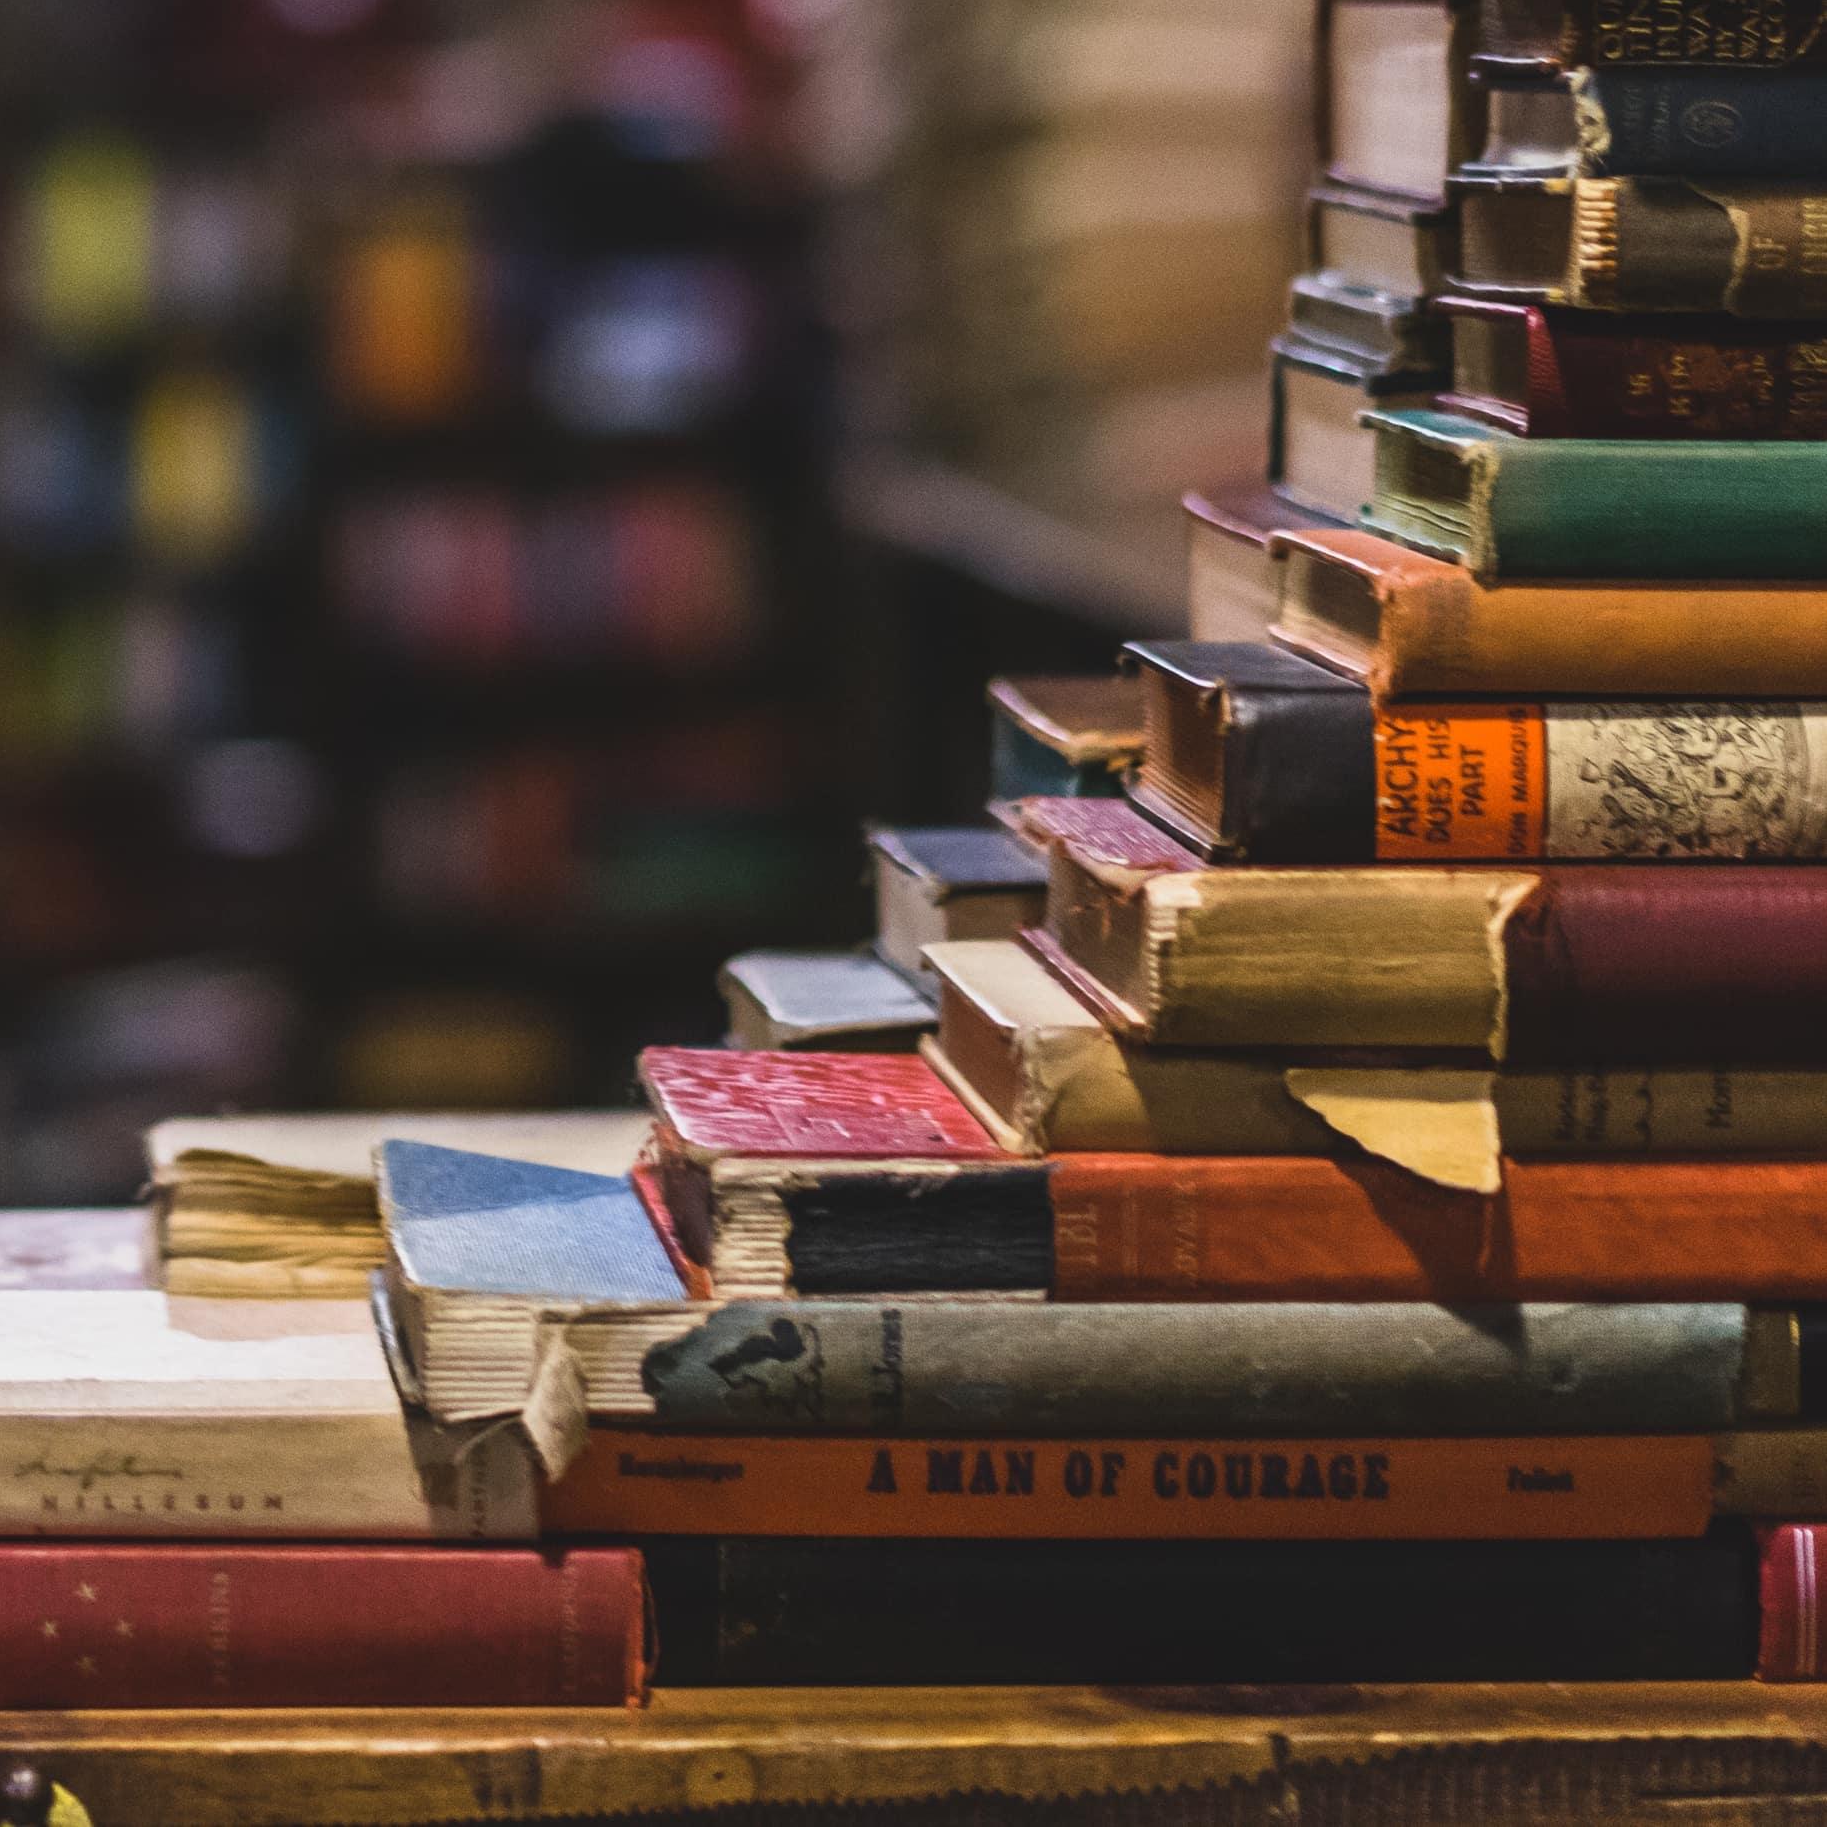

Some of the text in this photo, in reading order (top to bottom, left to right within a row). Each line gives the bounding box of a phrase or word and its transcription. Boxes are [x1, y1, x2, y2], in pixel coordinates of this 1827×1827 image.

[1382, 720, 1419, 838] ARCHY
[1425, 718, 1453, 843] DOES HIS
[1458, 744, 1486, 817] PART
[41, 1492, 284, 1512] HILLESUM
[865, 1450, 1392, 1500] A MAN OF COURAGE
